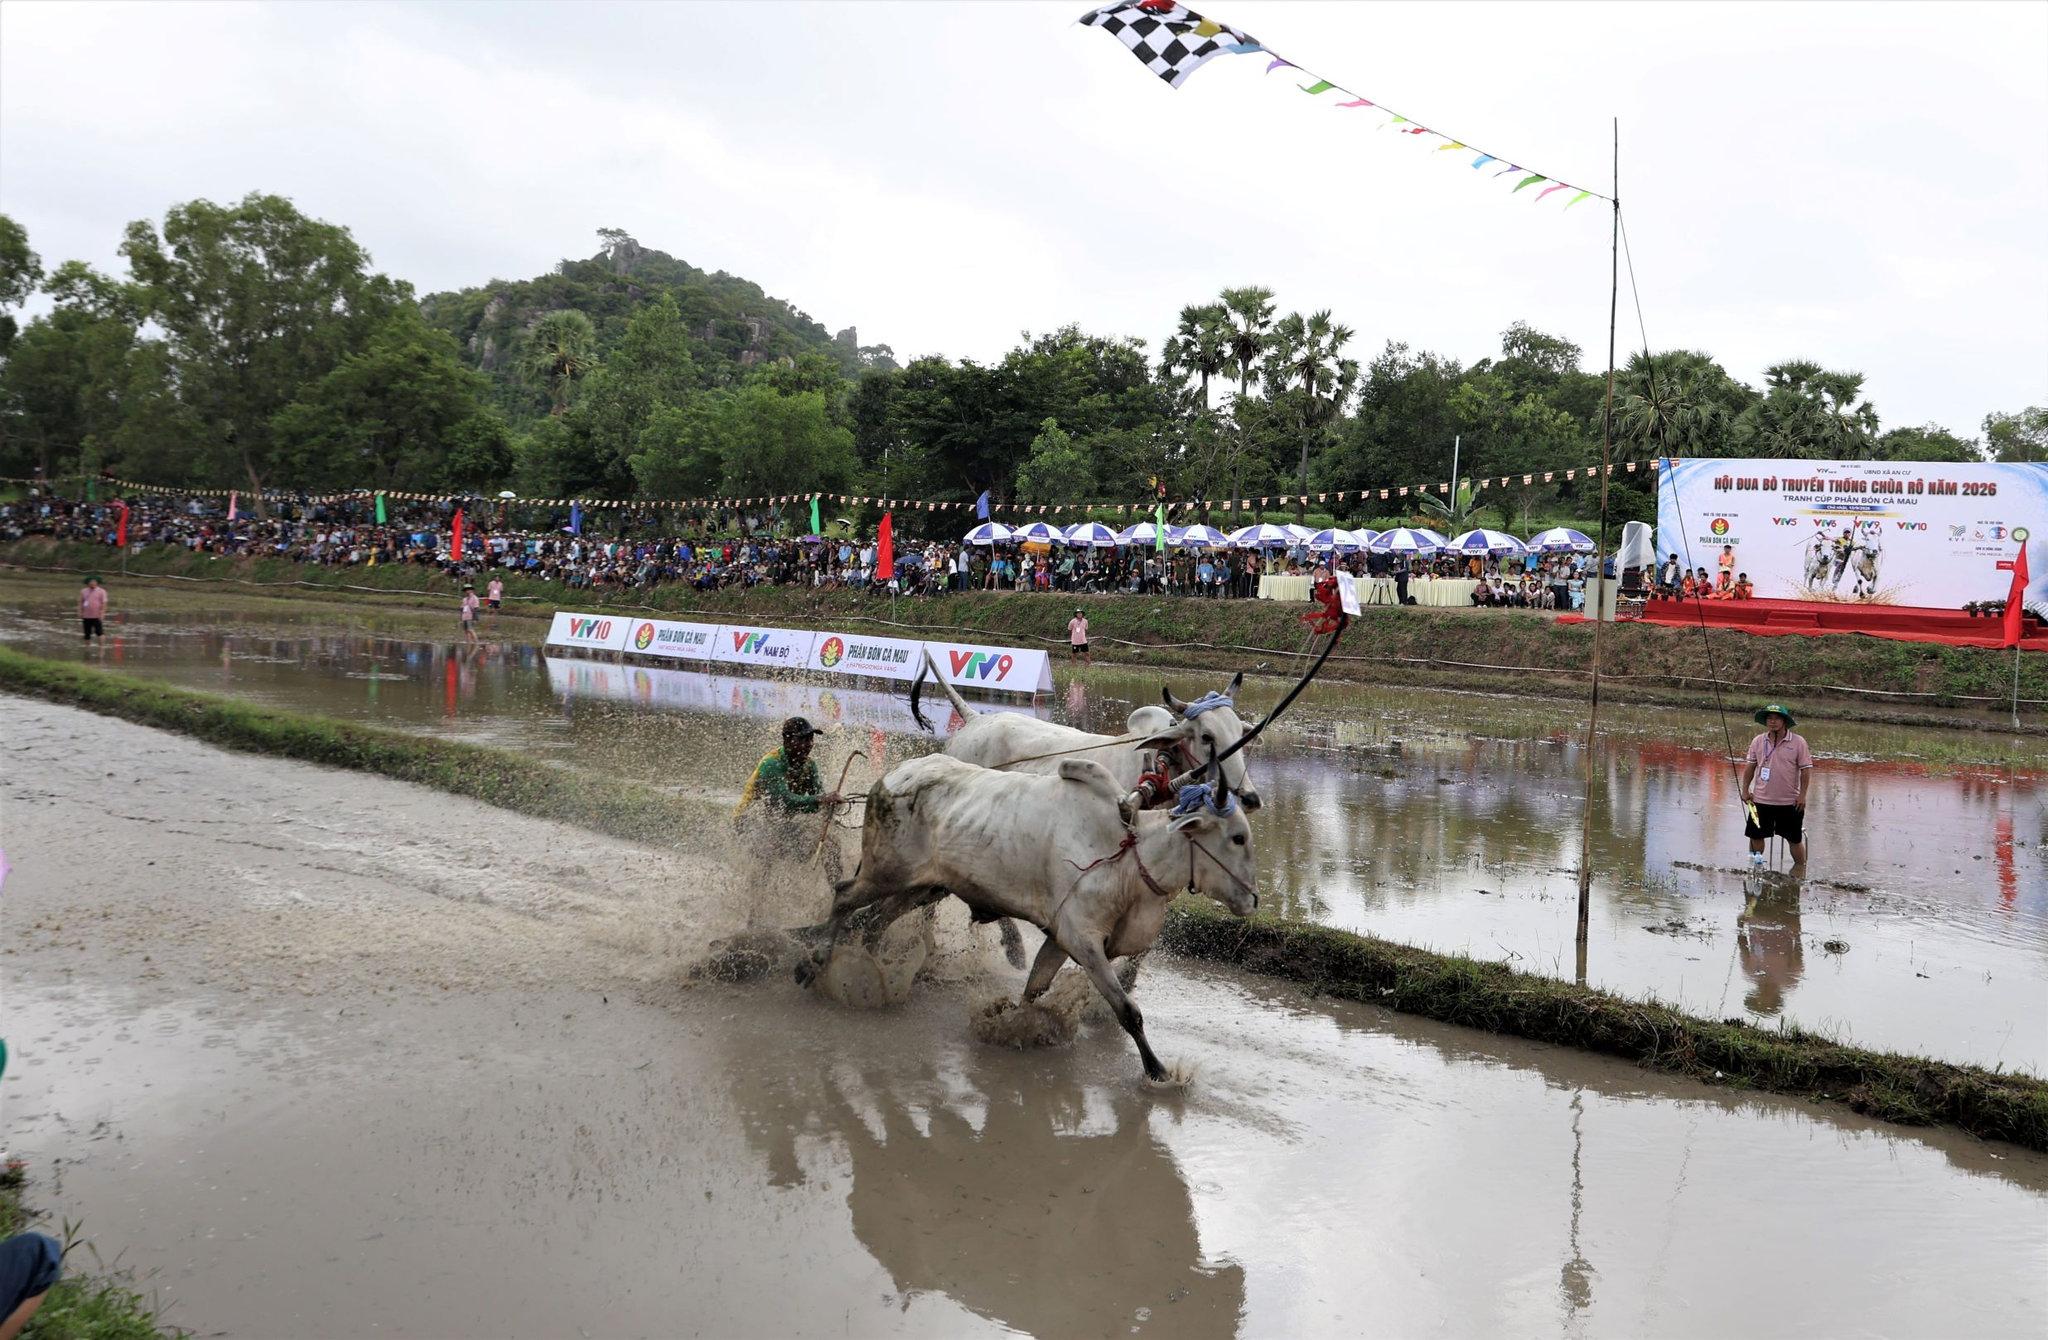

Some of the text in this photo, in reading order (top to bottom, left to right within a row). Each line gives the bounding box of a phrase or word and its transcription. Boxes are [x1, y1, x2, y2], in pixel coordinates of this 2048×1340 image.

[1714, 474, 1733, 492] HỘI
[1736, 478, 1759, 490] ĐUA
[1762, 476, 1778, 491] BÒ
[1829, 476, 1867, 494] THỐNG
[1871, 478, 1903, 494] CHÙA
[1908, 478, 1924, 495] RÔ
[1928, 479, 1958, 496] NĂM
[1962, 482, 1997, 496] 2026
[1814, 494, 1832, 503] CÚP
[1834, 494, 1859, 503] PHÂN
[1862, 496, 1880, 504] BÓN
[1882, 496, 1894, 504] CÀ
[1772, 518, 1798, 526] VTV5
[1814, 519, 1836, 528] VTV6
[1854, 520, 1880, 529] VTV9
[1897, 522, 1927, 530] VTV10
[570, 618, 612, 640] VTV10
[734, 631, 770, 654] VTV
[764, 646, 779, 657] NAM
[848, 643, 909, 664] PHÂN BÓN CÀ MAU
[950, 650, 1014, 682] VTV9
